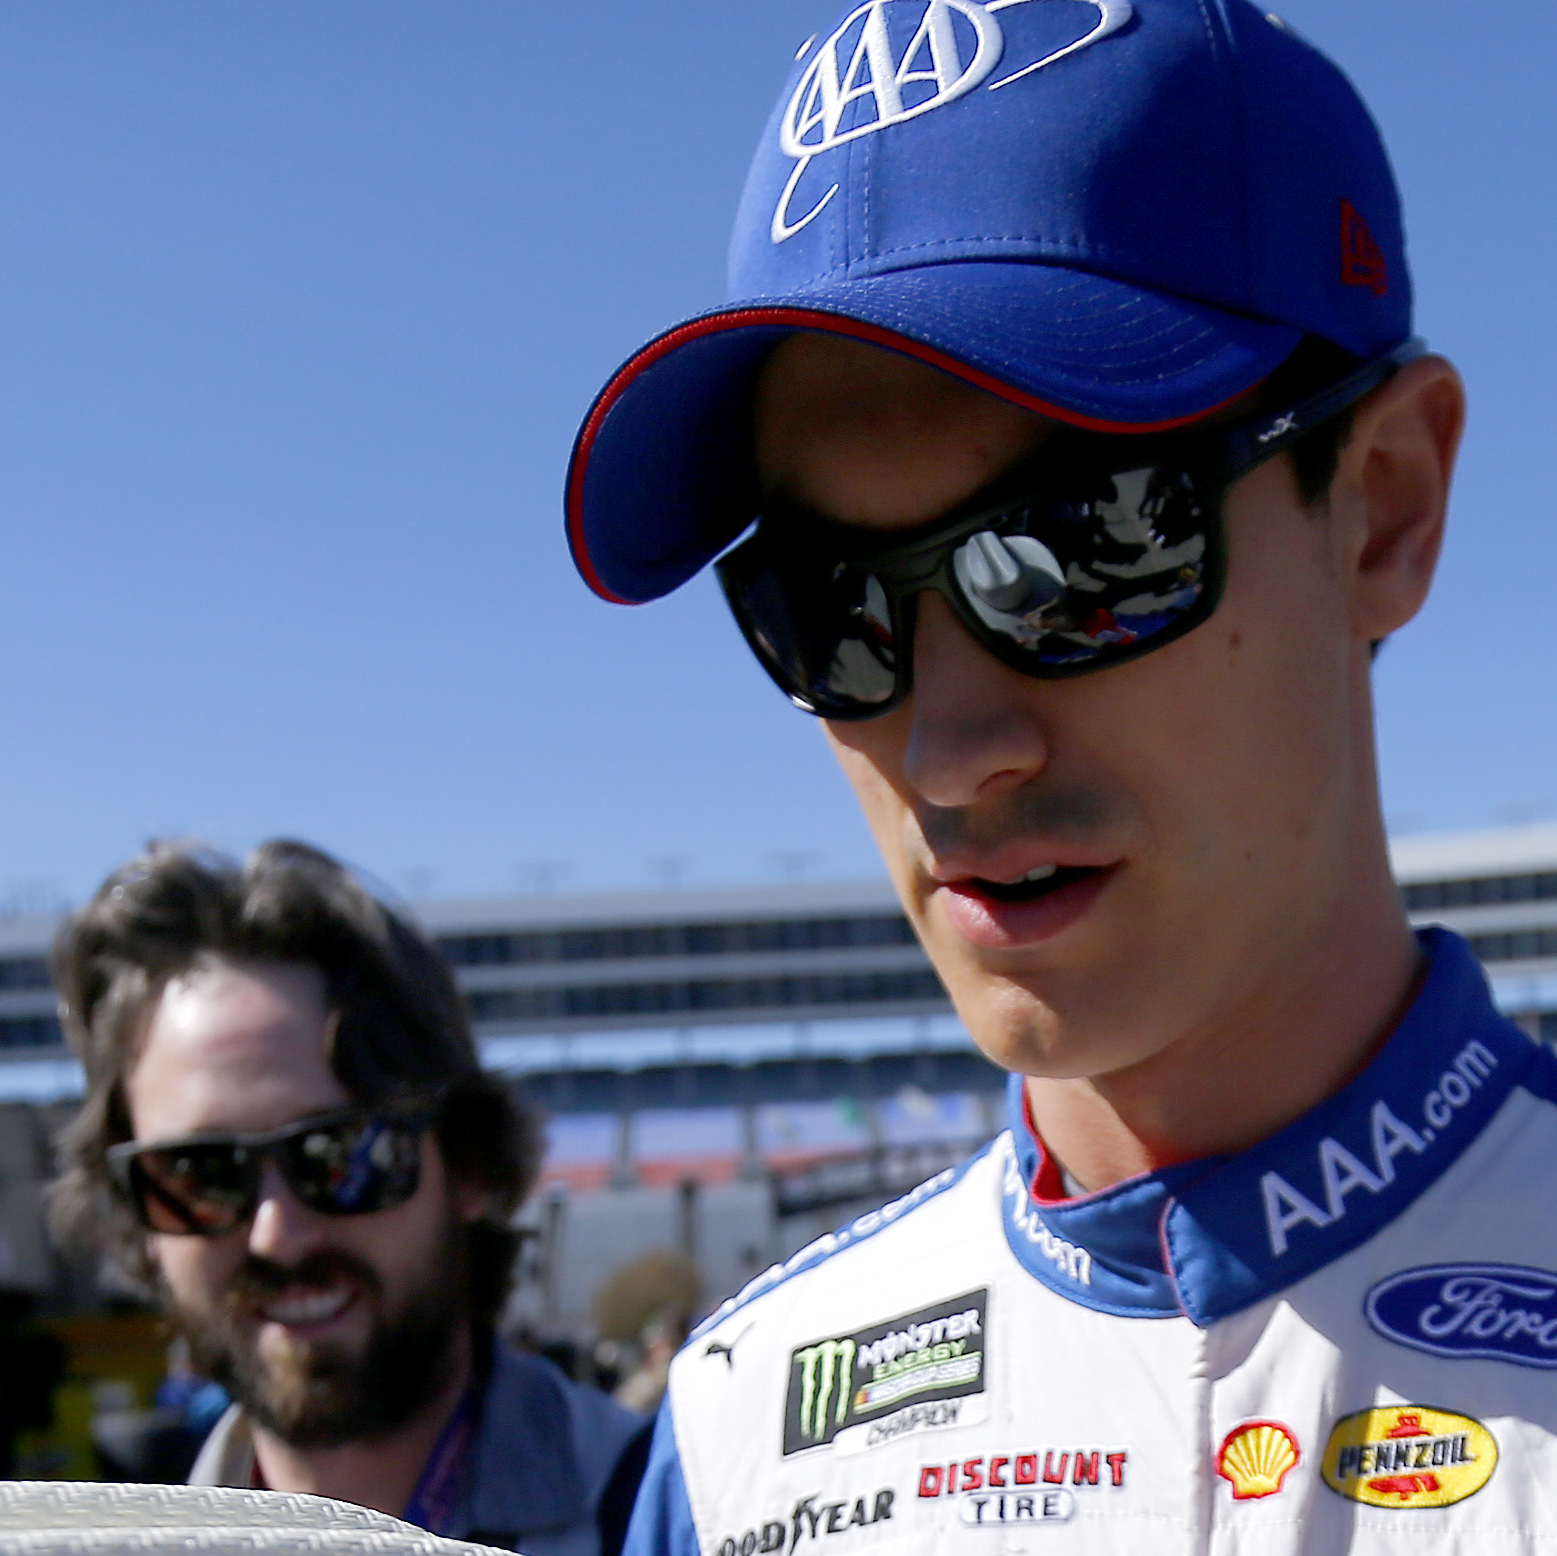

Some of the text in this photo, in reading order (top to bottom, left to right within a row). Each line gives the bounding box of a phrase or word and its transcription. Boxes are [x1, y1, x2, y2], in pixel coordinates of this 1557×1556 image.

[794, 0, 963, 143] AAA
[1261, 1038, 1499, 1258] AAA.com
[857, 1308, 982, 1369] MONSTER
[873, 1339, 967, 1381] ENERGY
[918, 1451, 1128, 1499] DISCOUNT
[1338, 1435, 1479, 1479] PENNZOIL
[971, 1493, 1062, 1525] TIRE
